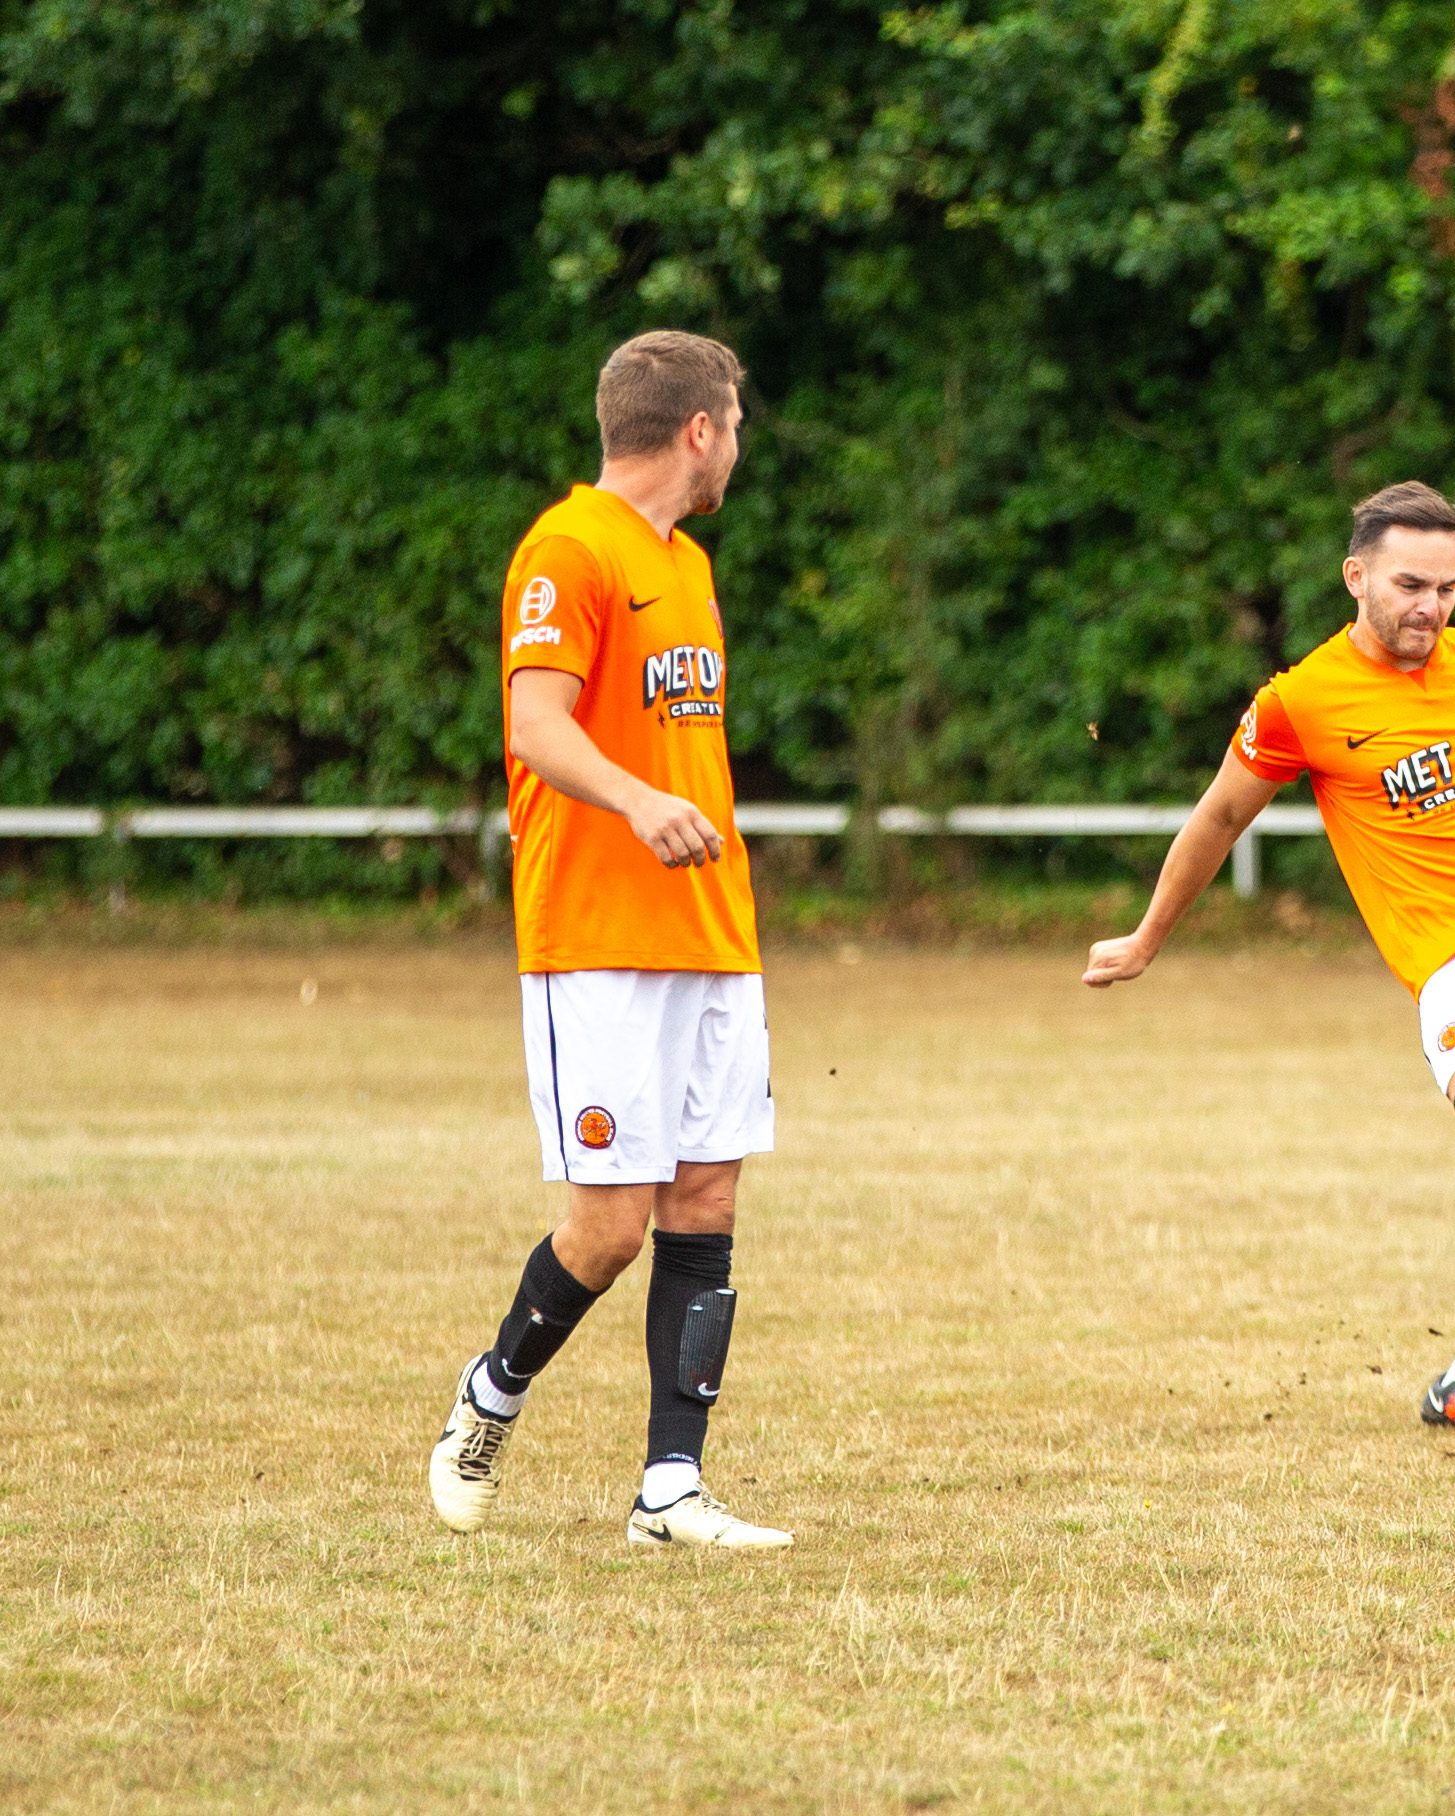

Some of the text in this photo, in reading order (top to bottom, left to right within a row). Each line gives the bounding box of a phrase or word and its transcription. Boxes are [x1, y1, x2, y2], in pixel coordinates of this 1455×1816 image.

[644, 645, 695, 704] MET
[671, 702, 721, 716] CREATIV
[1382, 741, 1452, 806] MET
